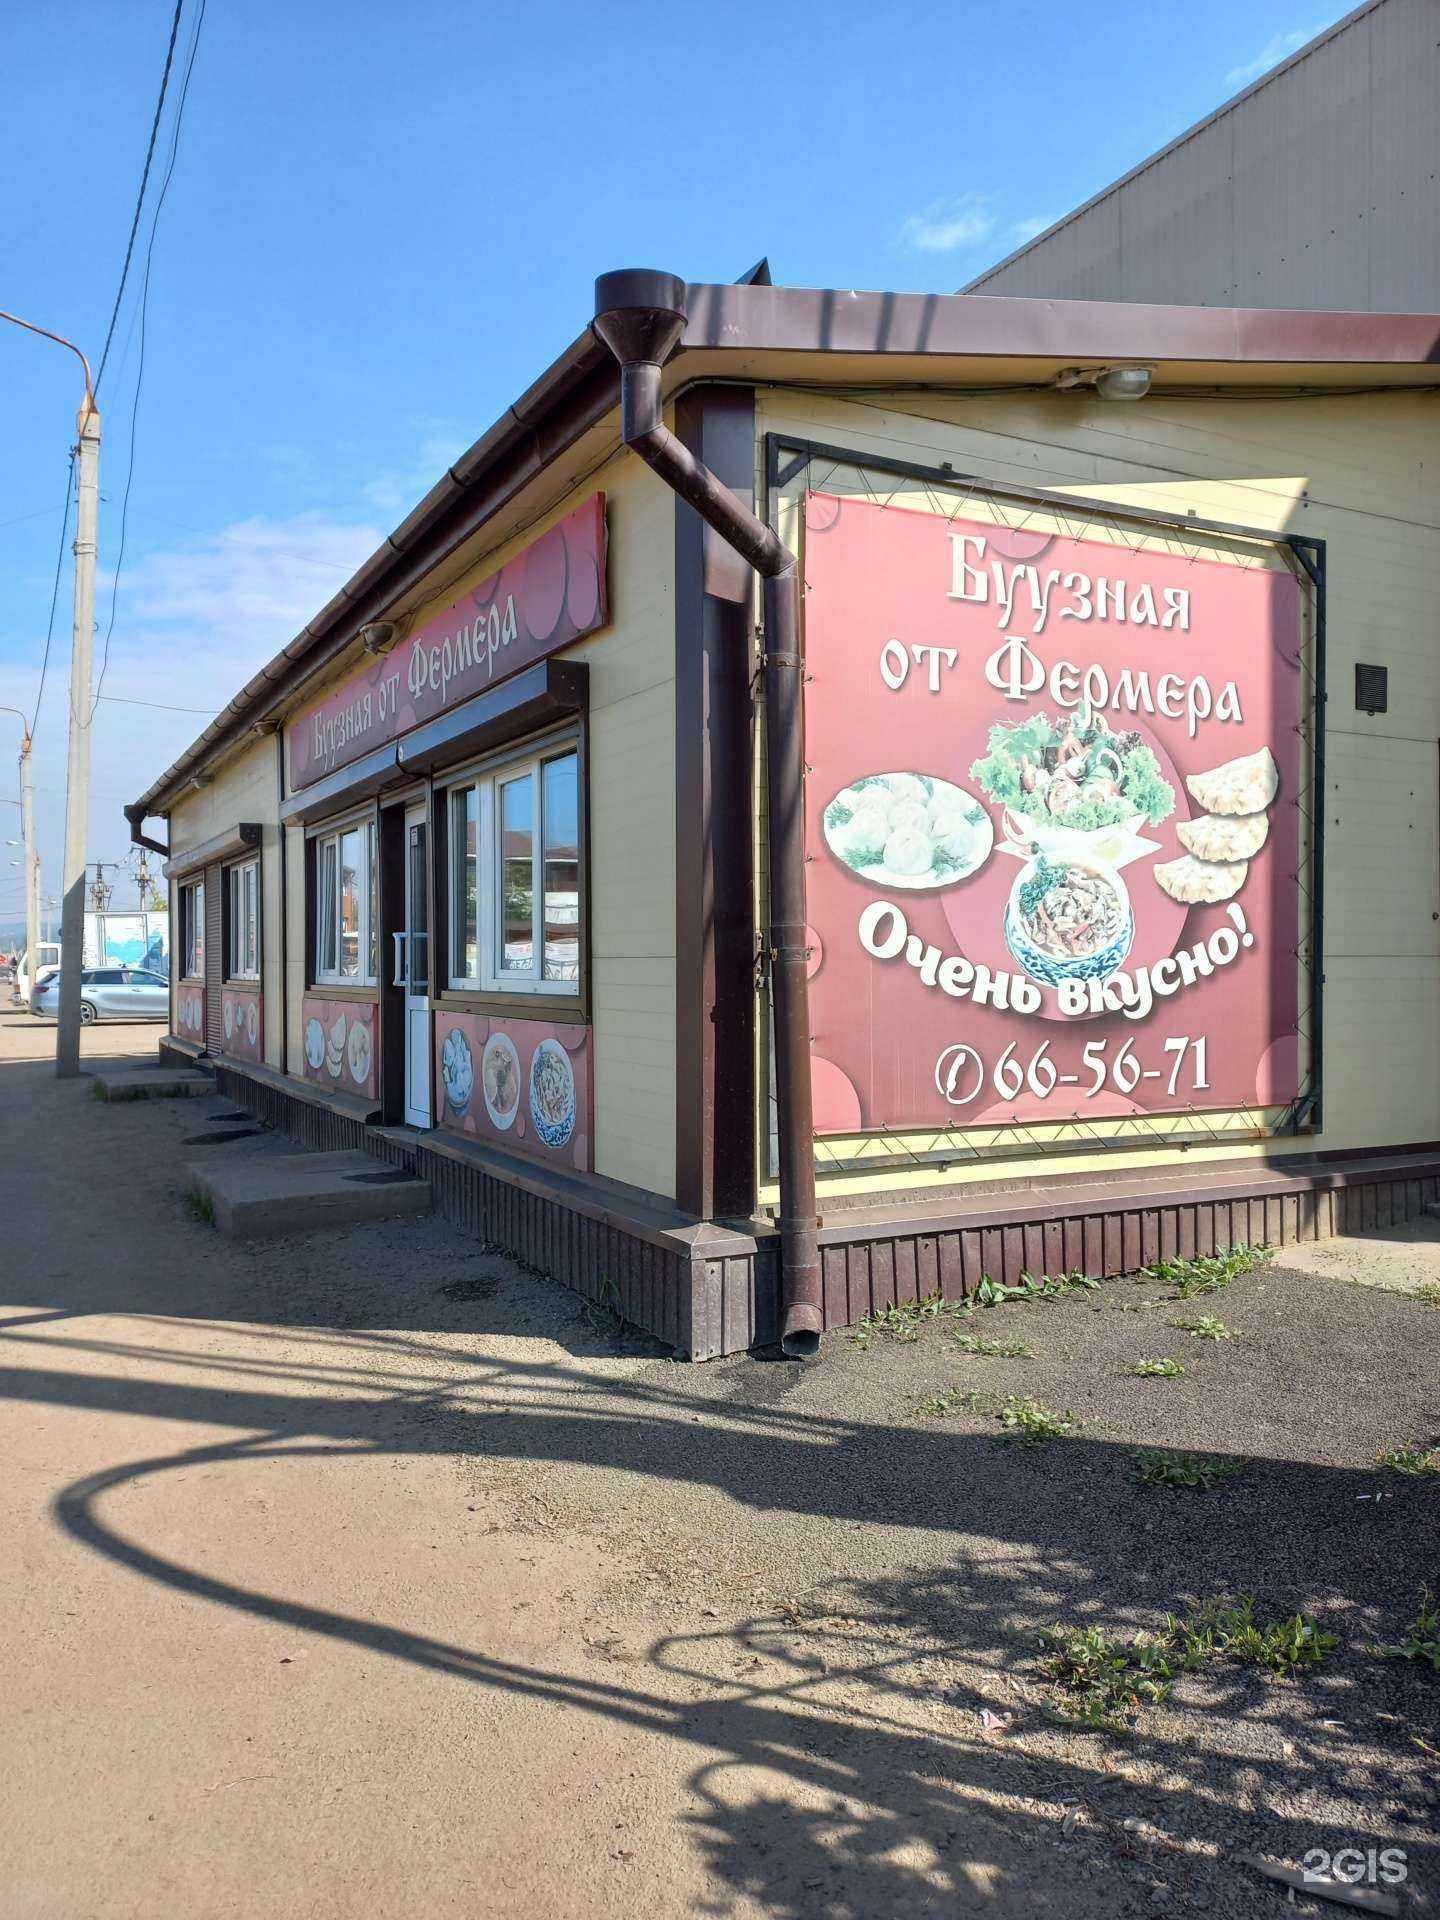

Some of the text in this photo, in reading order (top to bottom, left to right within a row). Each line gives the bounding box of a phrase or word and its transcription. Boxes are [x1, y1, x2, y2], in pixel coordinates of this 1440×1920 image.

[946, 532, 1190, 633] Буузная
[313, 594, 519, 771] Буузная от Фермера
[879, 635, 1244, 738] от Фермера
[857, 900, 1254, 1019] Очень вкусно!
[993, 1034, 1211, 1101] 66-56-71
